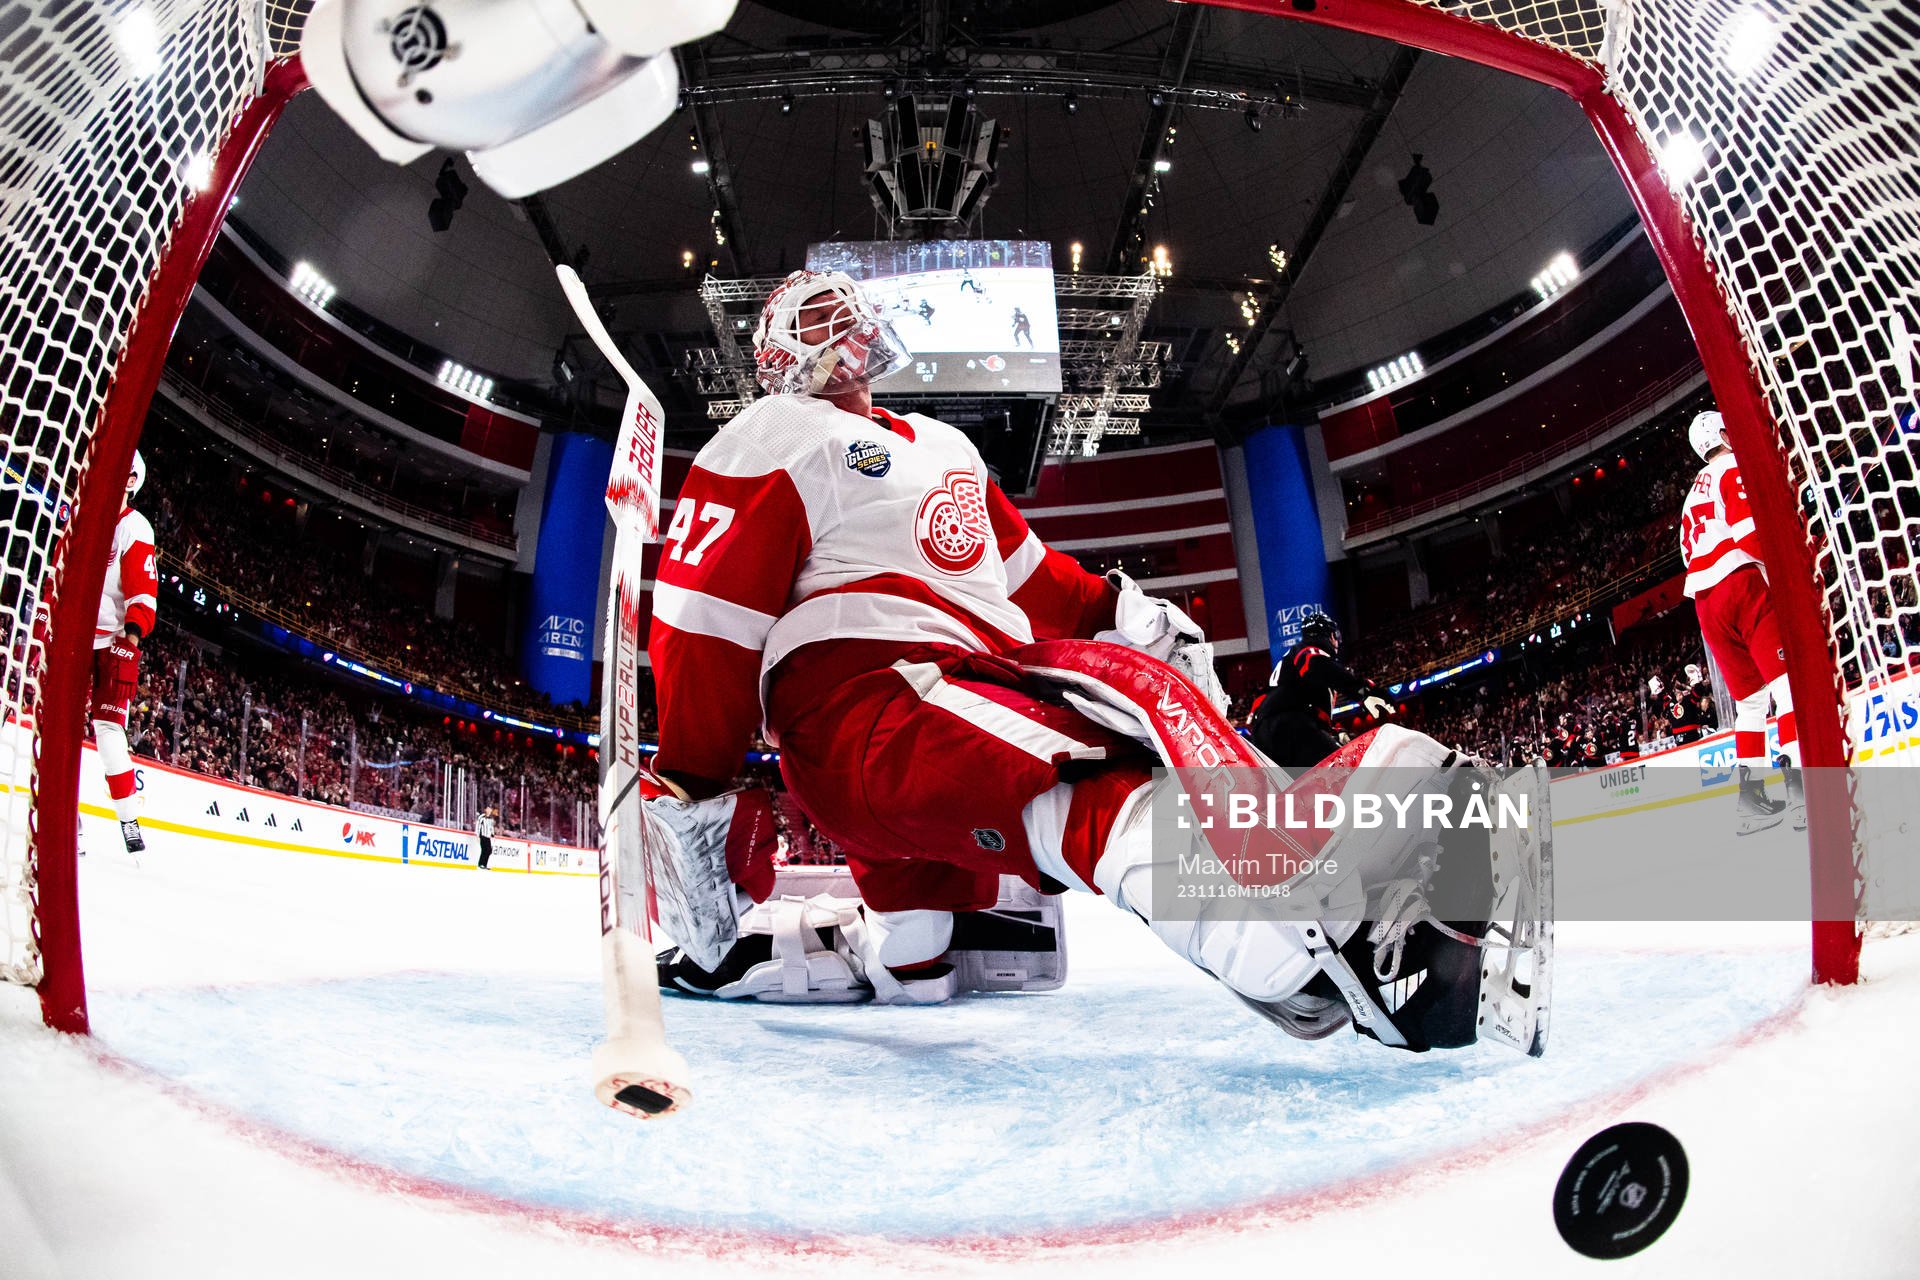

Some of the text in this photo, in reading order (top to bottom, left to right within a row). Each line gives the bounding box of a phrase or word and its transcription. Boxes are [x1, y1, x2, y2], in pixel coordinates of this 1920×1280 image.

[628, 401, 658, 487] BAUER
[847, 445, 889, 466] GLOBAL
[857, 454, 886, 469] SERIES
[665, 496, 736, 567] 47
[143, 554, 157, 580] 4
[539, 615, 585, 634] AVIC
[1863, 693, 1919, 742] FAS
[1157, 682, 1237, 805] VAPOR
[1600, 765, 1646, 790] UNIBET
[1701, 747, 1738, 782] SAP
[415, 831, 470, 861] FASTENAL
